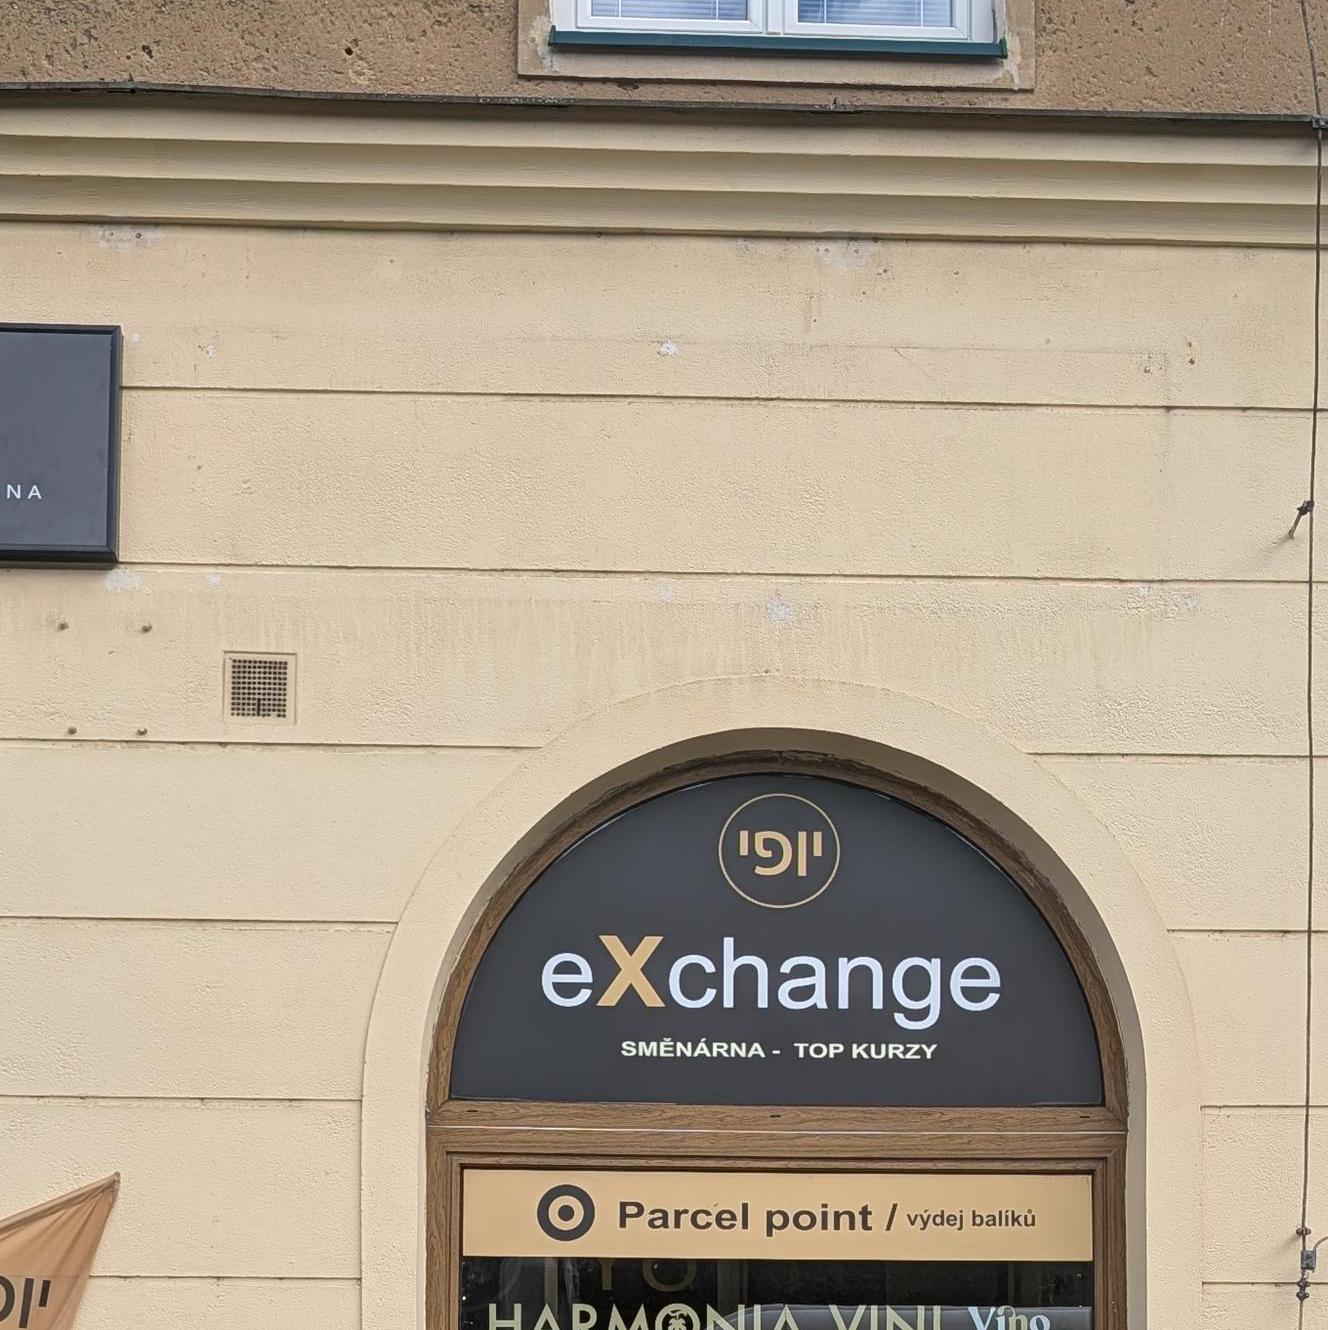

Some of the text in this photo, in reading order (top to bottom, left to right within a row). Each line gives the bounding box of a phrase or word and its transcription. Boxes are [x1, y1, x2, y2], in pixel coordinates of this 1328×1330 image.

[541, 934, 1002, 1031] eXchange
[620, 1037, 765, 1059] SMĚNÁRNA
[794, 1041, 845, 1060] TOP
[851, 1042, 939, 1061] KURZY
[619, 1201, 750, 1231] Parcel
[766, 1202, 873, 1238] point
[907, 1209, 965, 1231] výdej
[971, 1208, 1037, 1228] balíků
